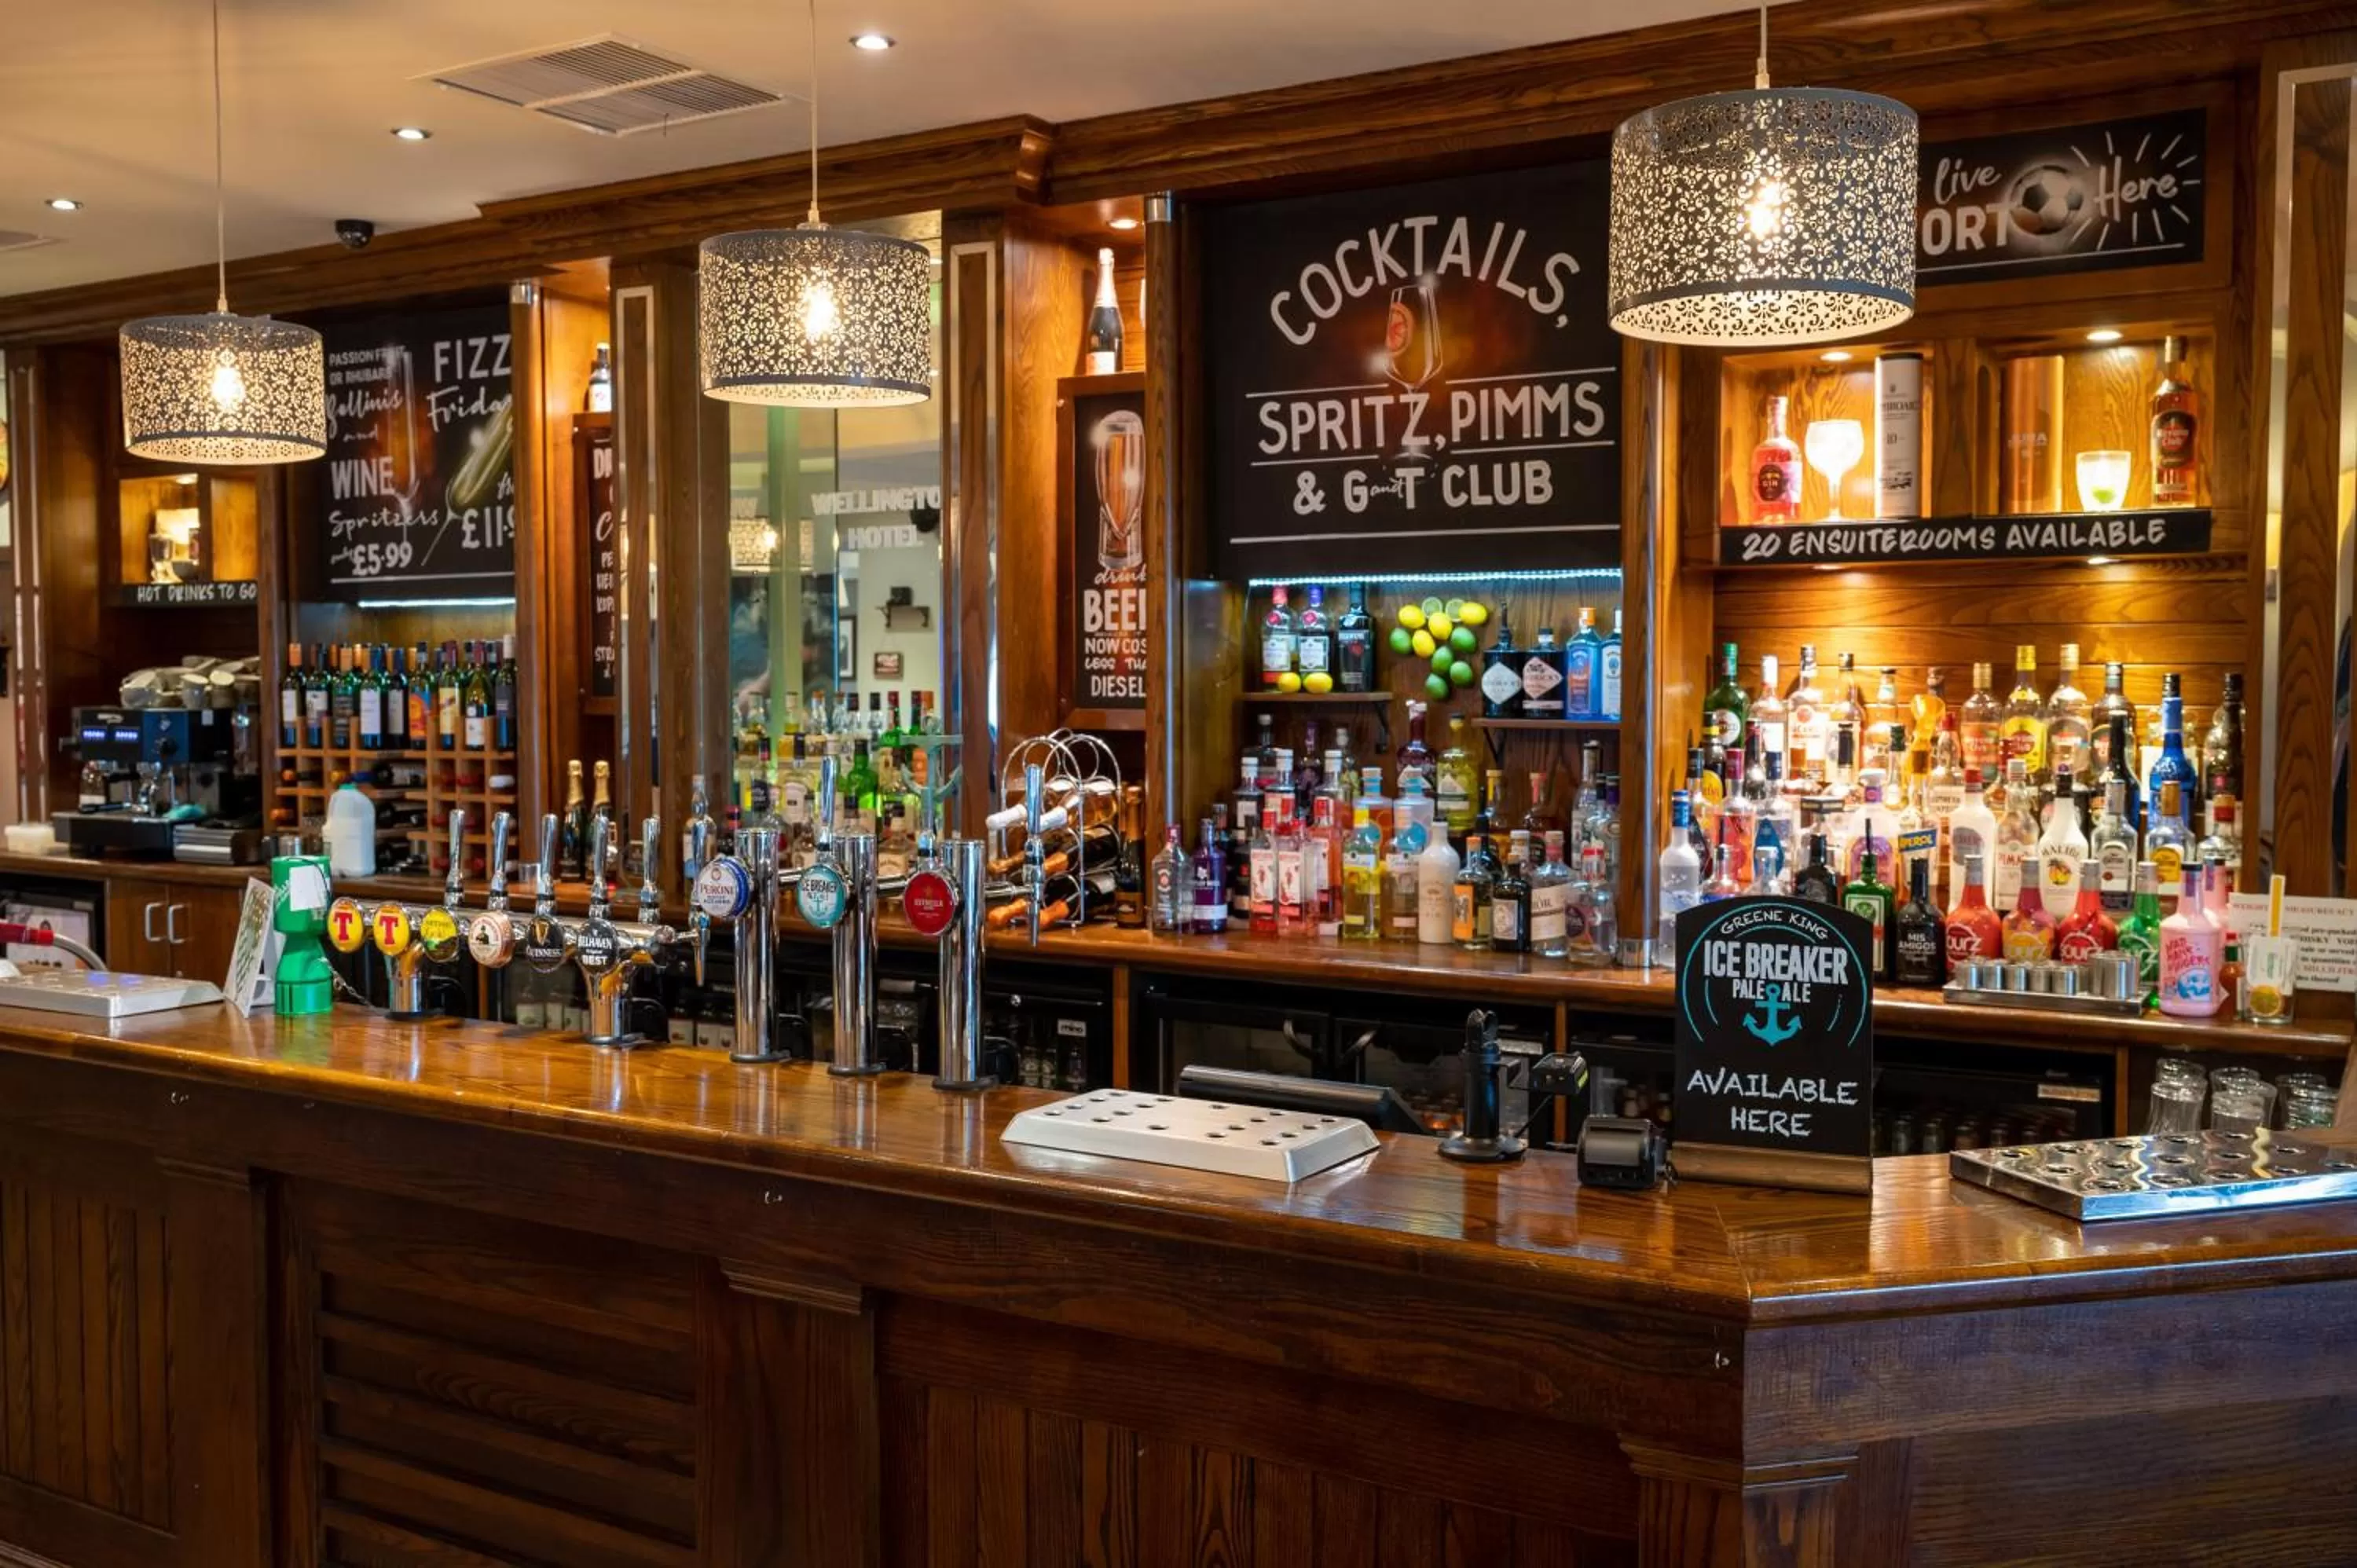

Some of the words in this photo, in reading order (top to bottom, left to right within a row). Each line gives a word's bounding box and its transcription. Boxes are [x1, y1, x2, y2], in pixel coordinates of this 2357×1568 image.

[2093, 155, 2179, 223] Here
[1270, 214, 1581, 346] COCKTAILS,
[328, 350, 375, 367] PASSION
[433, 333, 511, 383] FIZZ
[329, 371, 343, 386] OR
[1450, 382, 1605, 443] PIMMS
[331, 456, 396, 500] WINE
[1292, 471, 1328, 515] &
[1442, 460, 1554, 508] CLUB
[328, 507, 439, 541] Spritzers
[848, 524, 924, 549] HOTEL
[1741, 532, 1781, 562] 20
[2005, 518, 2168, 550] AVAILABLE
[351, 540, 413, 577] £5.99
[137, 585, 163, 603] HOT
[167, 583, 215, 603] DRINKS
[218, 583, 235, 600] TO
[238, 582, 258, 600] GO
[1084, 637, 1120, 655] NOW
[1091, 675, 1147, 698] DIESEL
[700, 884, 735, 896] PERONI
[333, 910, 354, 941] T
[379, 914, 399, 946] T
[1720, 910, 1783, 936] GREENE
[1788, 912, 1830, 940] KING
[581, 955, 608, 966] BEST
[1703, 940, 1742, 978] ICE
[1744, 942, 1849, 985] BREAKER
[1732, 978, 1765, 1001] PALE
[1781, 981, 1811, 1003] ALE
[1687, 1066, 1859, 1105] AVAILABLE
[1730, 1105, 1813, 1138] HERE
